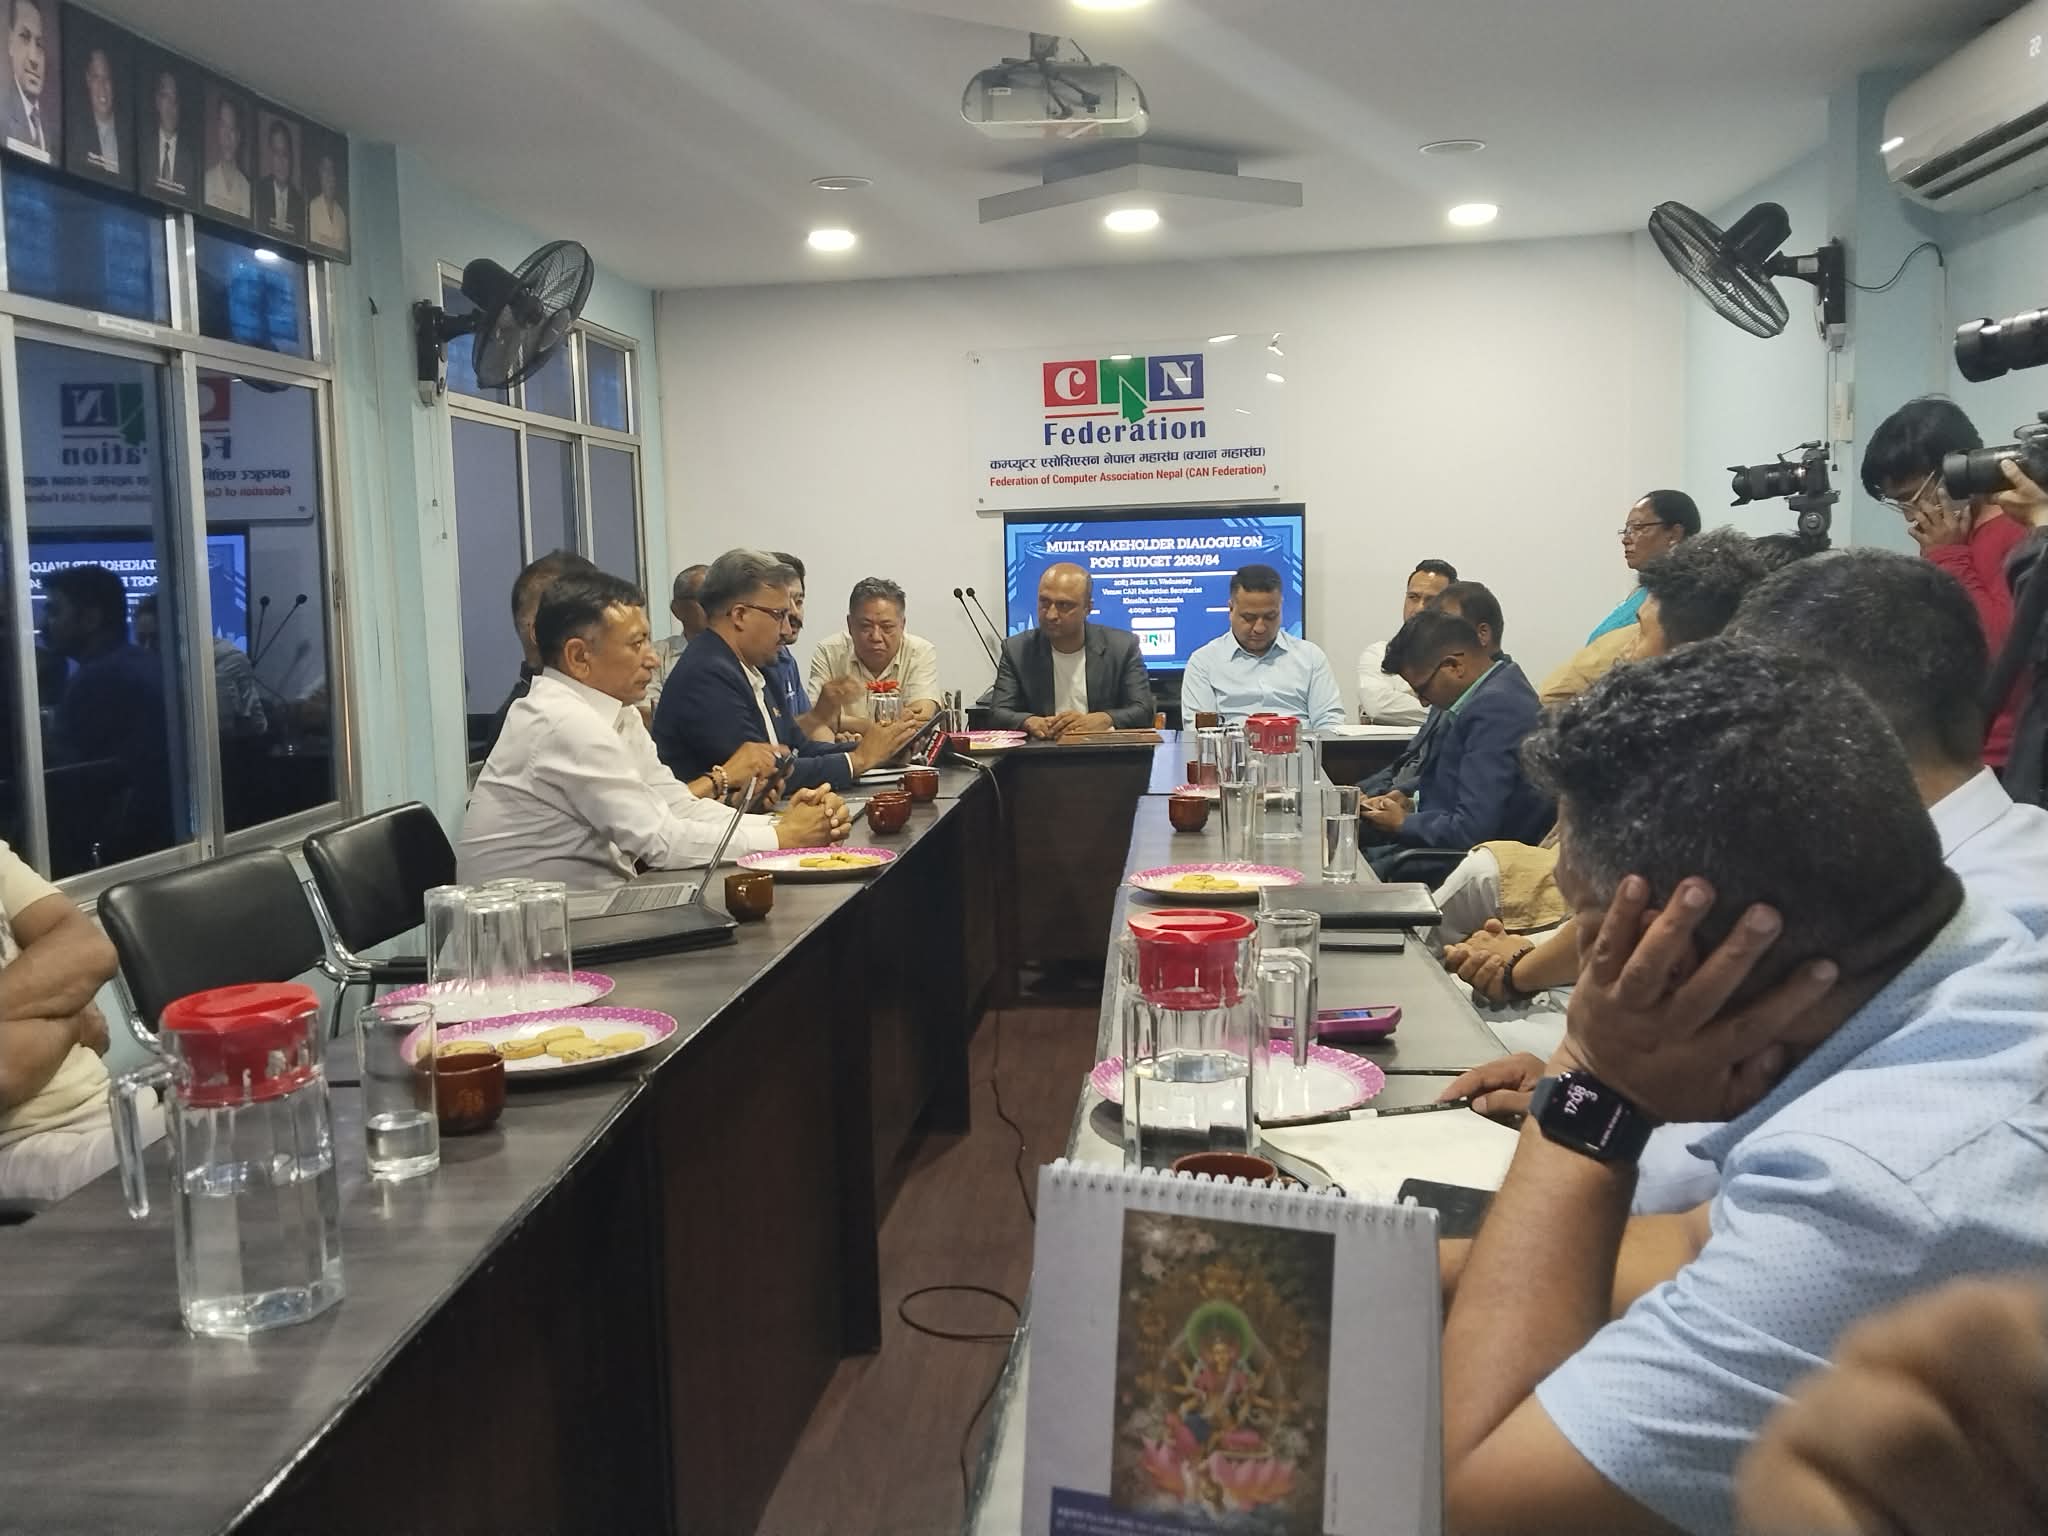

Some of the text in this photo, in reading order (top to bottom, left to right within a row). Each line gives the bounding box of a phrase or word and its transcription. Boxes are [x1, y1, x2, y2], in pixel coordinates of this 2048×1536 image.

[1044, 417, 1207, 446] Federation
[1104, 452, 1135, 464] नेपाल
[1139, 450, 1179, 463] महासंघ
[1183, 449, 1217, 461] (क्यान
[1221, 446, 1266, 459] महासंघ)
[990, 464, 1267, 487] Federation of Computer Association Nepal (CAN Federation)
[1046, 535, 1263, 553] MULTI-STAKEHOLDER DIALOGUE ON
[1089, 553, 1220, 569] POST BUDGET 2083/84
